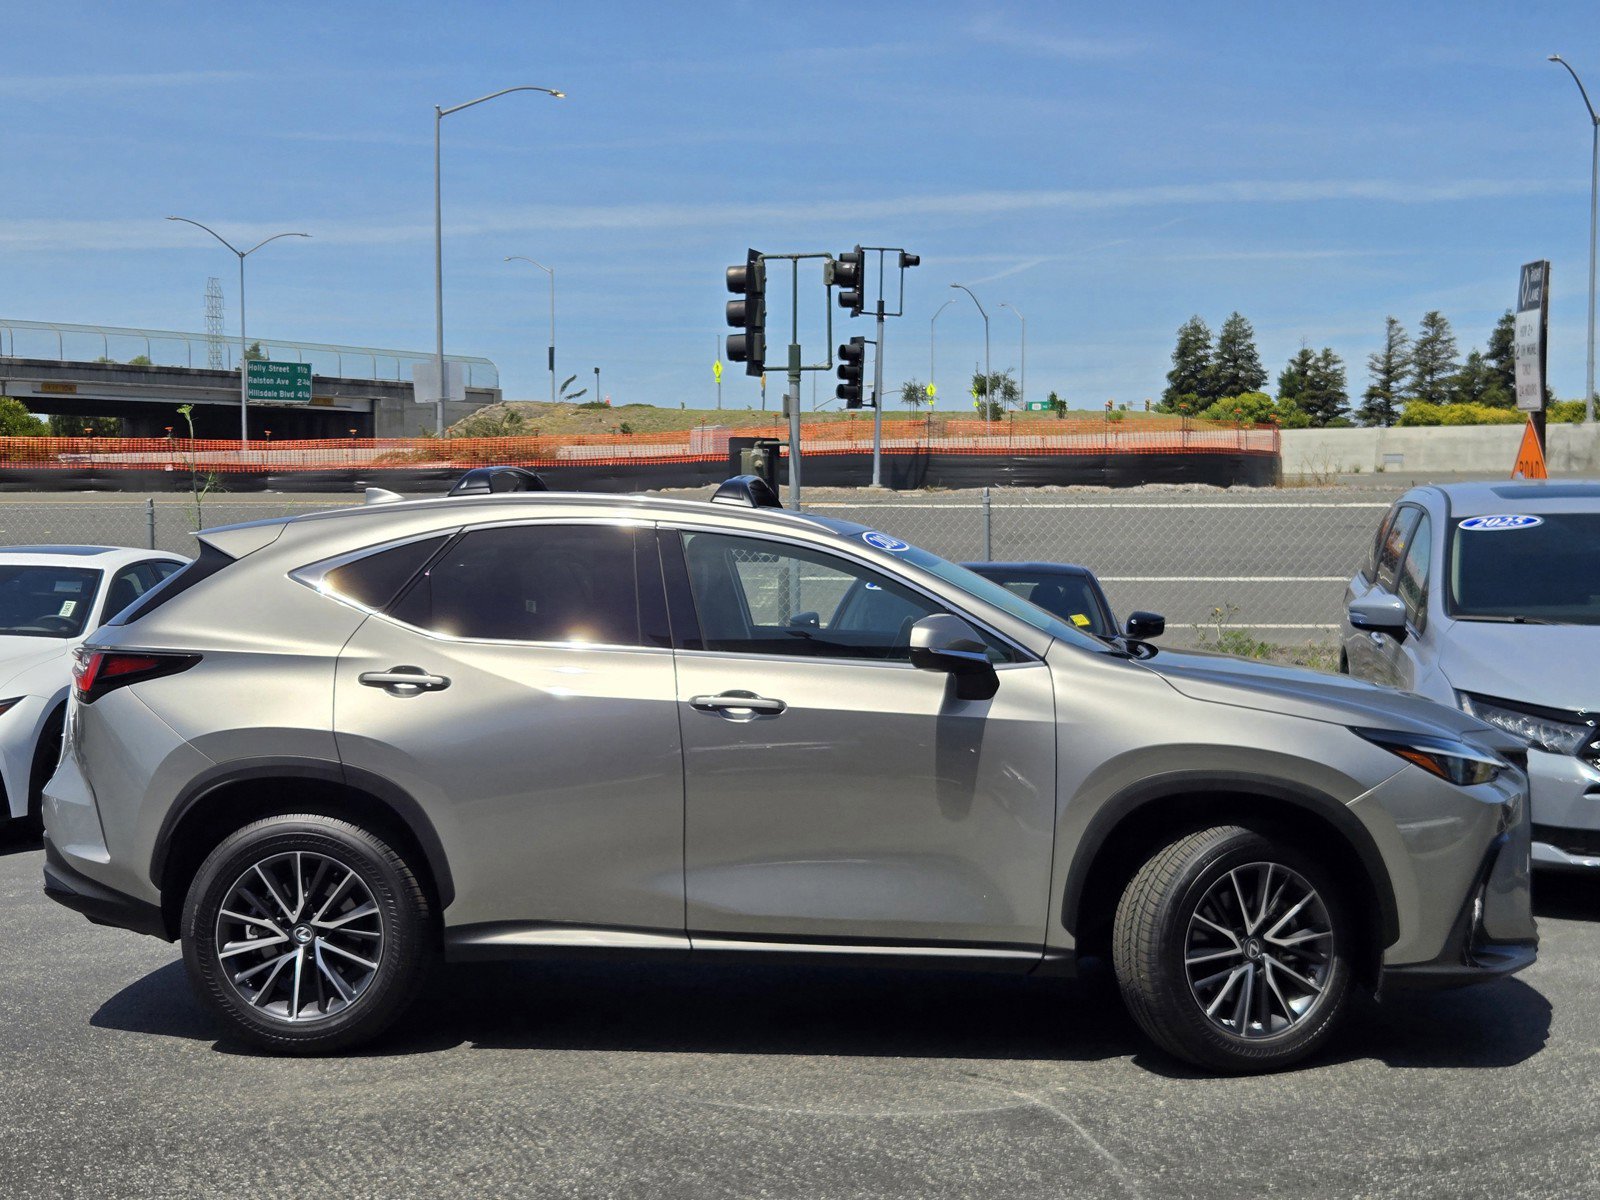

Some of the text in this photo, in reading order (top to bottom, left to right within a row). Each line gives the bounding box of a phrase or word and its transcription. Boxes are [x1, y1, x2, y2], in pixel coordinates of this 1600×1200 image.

[248, 363, 266, 373] Holly
[268, 365, 290, 373] Street
[248, 376, 275, 385] Ralston
[276, 378, 290, 386] Ave
[248, 389, 278, 398] Hillsdale
[279, 390, 295, 398] Blvd
[1472, 515, 1530, 529] 2025
